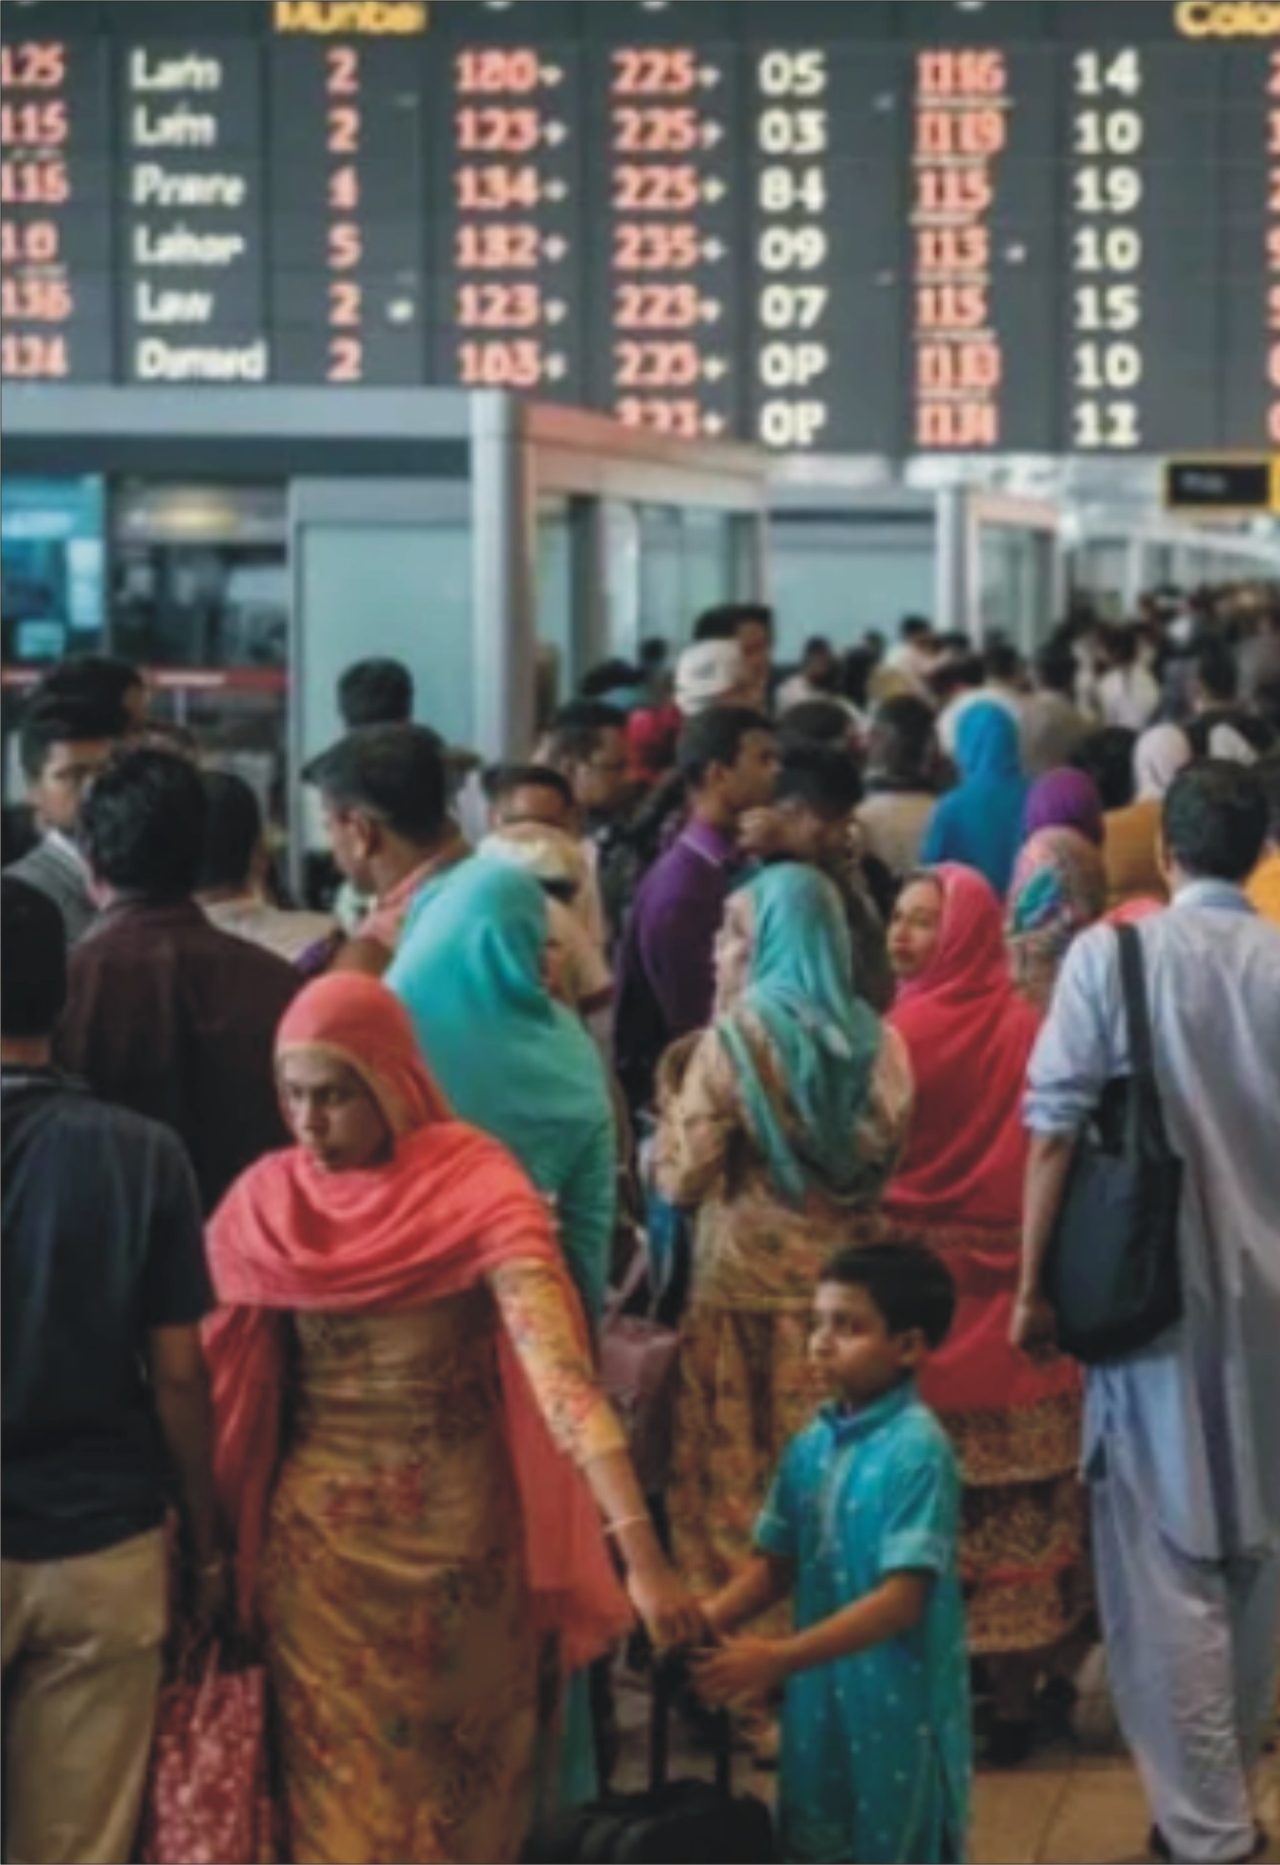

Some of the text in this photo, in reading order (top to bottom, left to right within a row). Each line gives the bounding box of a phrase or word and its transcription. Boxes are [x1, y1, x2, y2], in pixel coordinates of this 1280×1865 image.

[328, 48, 357, 94] 2
[1077, 50, 1139, 94] 14
[330, 107, 358, 151] 2
[1077, 110, 1141, 153] 10
[1076, 167, 1141, 212] 19
[330, 224, 360, 267] 5
[760, 227, 826, 270] 09
[1076, 228, 1140, 271] 10
[331, 282, 359, 325] 2
[761, 285, 827, 328] 07
[1077, 285, 1139, 330] 15
[331, 339, 361, 380] 2
[1077, 343, 1140, 388] 10
